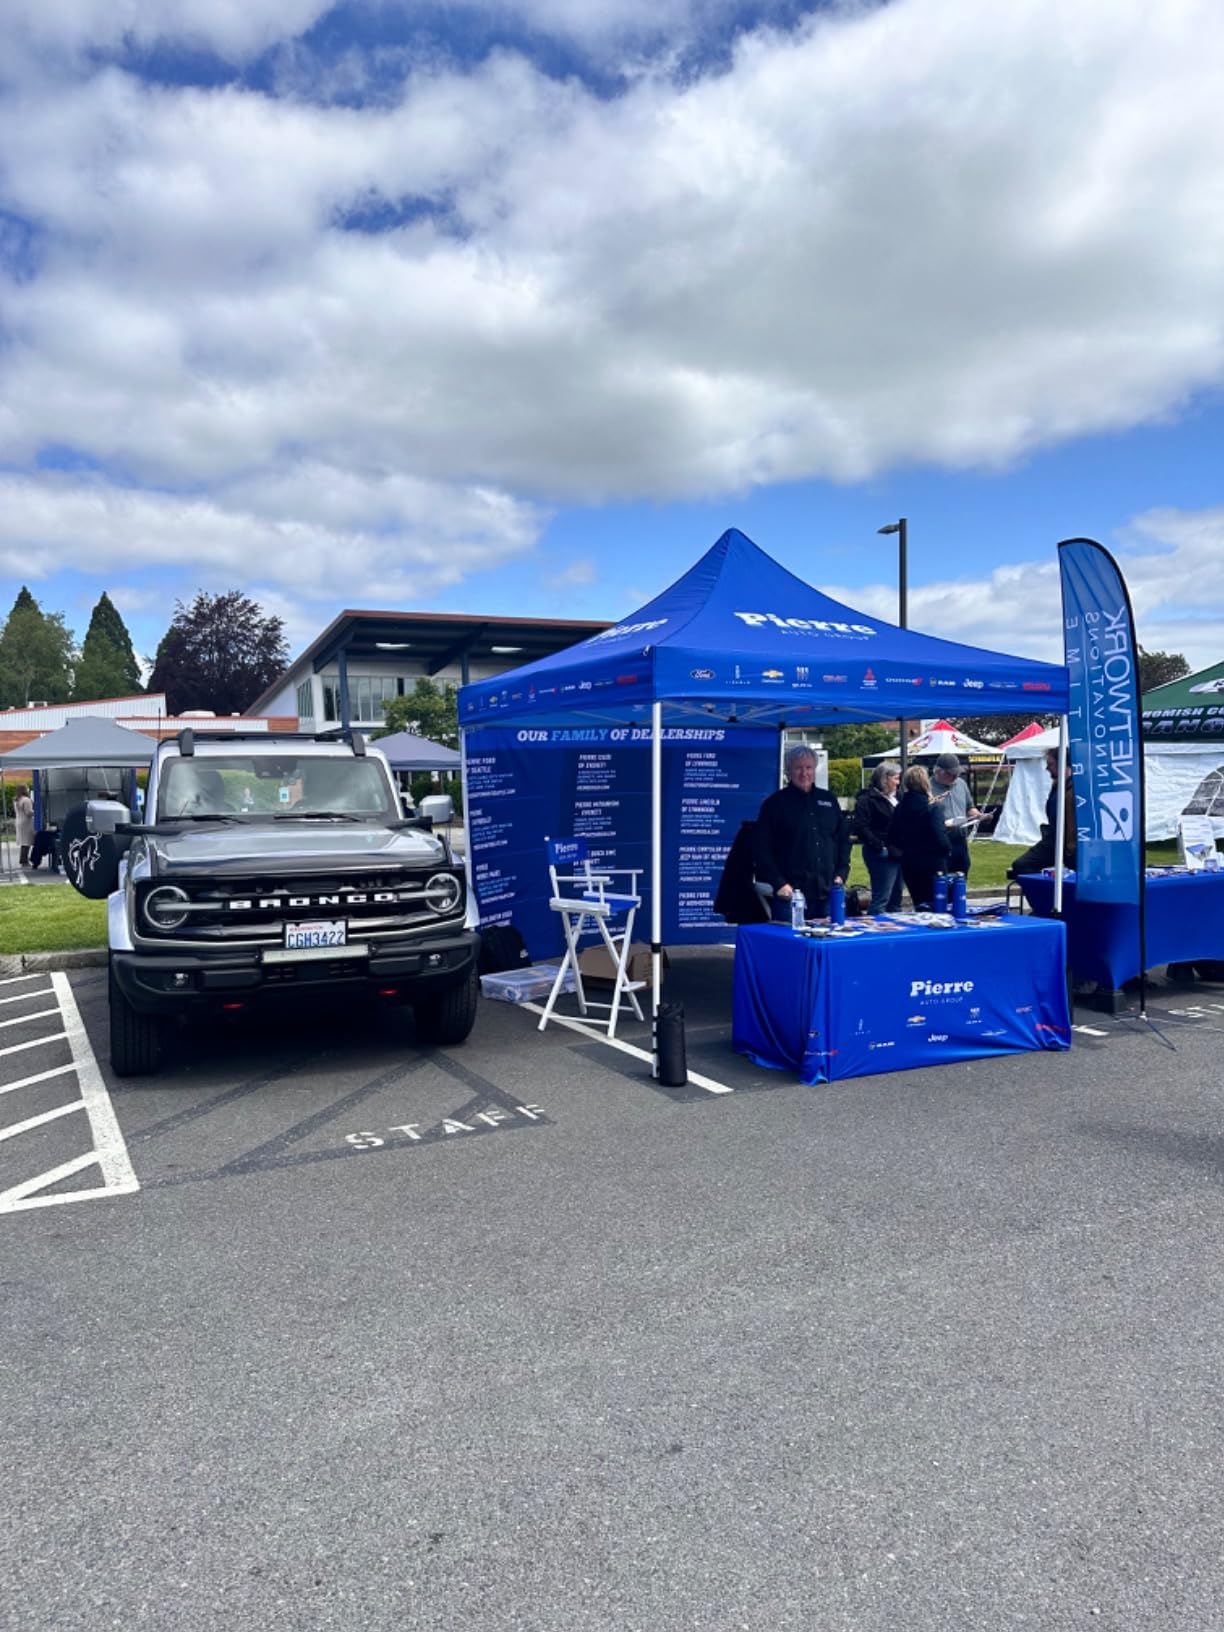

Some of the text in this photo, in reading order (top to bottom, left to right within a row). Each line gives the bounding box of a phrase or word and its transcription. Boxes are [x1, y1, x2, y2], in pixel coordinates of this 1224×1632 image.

[734, 611, 877, 635] Pierre
[962, 678, 984, 690] Jeep
[1142, 706, 1205, 719] HOMISH
[517, 728, 725, 742] OUR FAMILY OF DELERSHIPS
[229, 892, 394, 910] BRONCO
[287, 930, 344, 948] CGH3422
[910, 980, 974, 997] Pierre
[344, 1103, 545, 1150] STAFF
